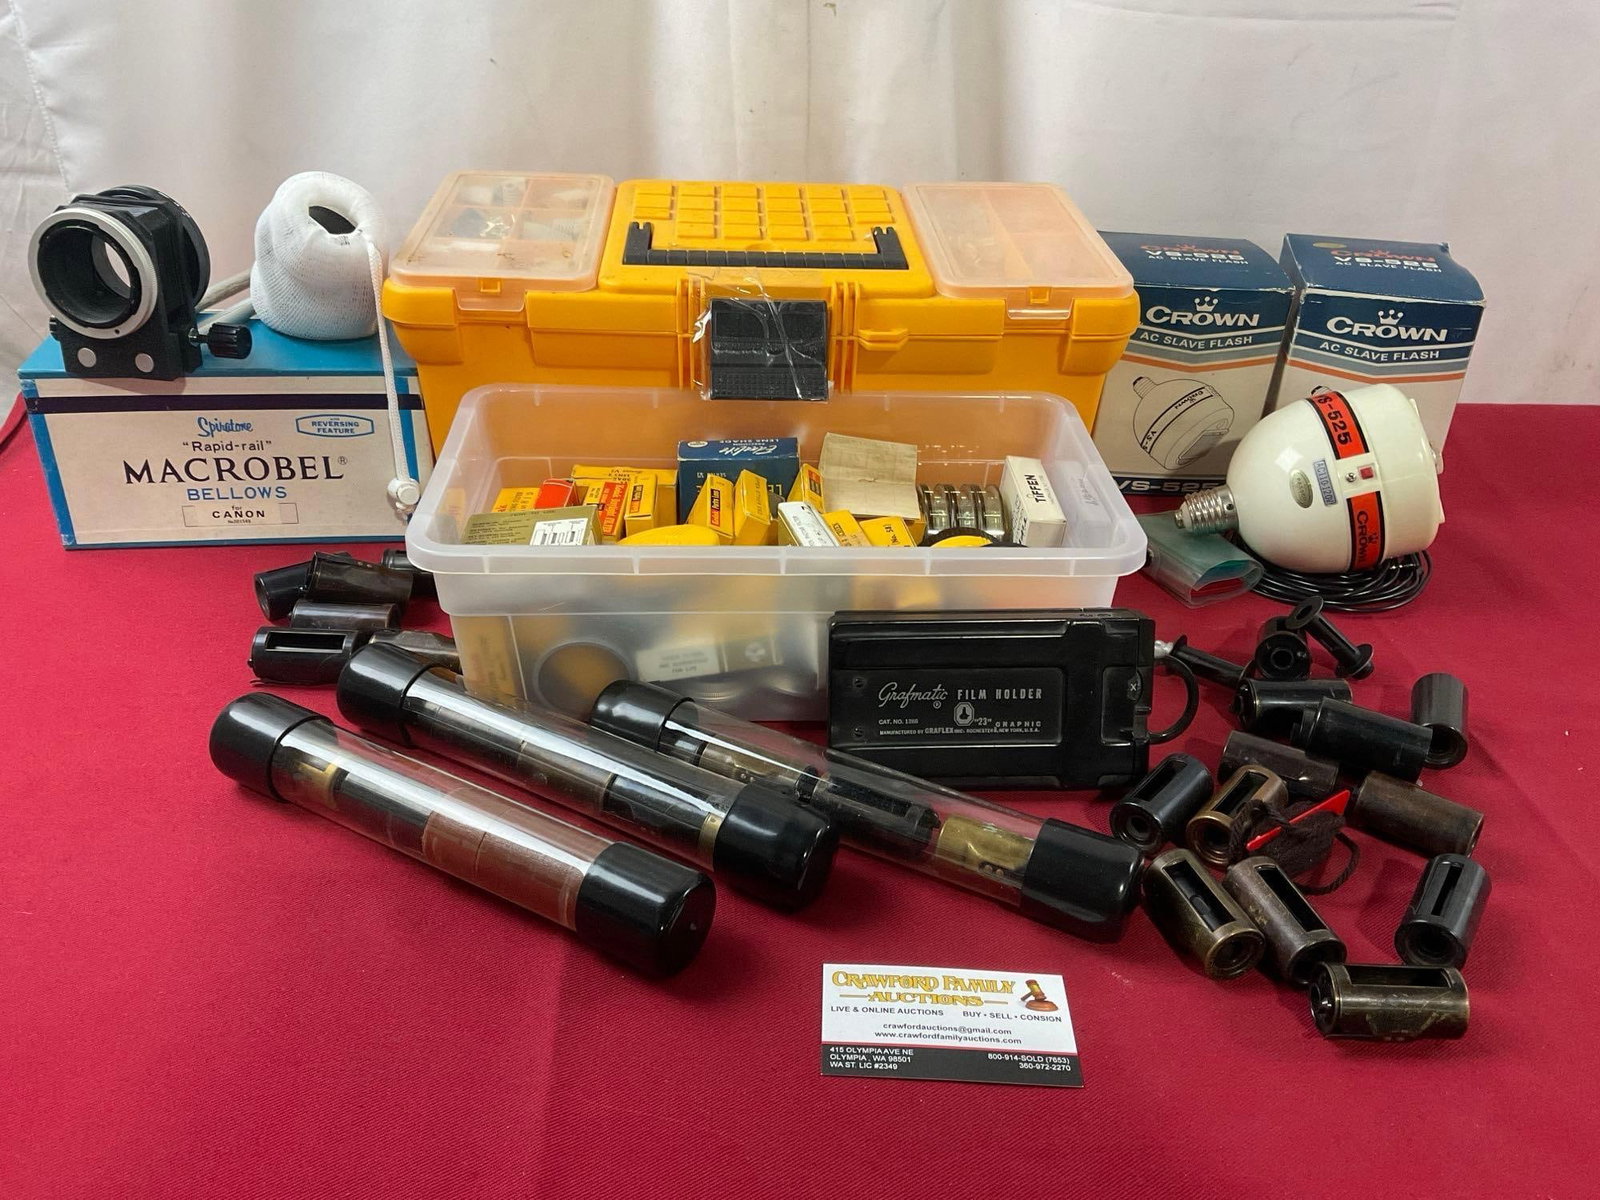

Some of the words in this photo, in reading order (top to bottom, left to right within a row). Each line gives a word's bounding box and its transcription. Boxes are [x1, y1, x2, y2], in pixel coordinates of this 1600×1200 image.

[1145, 250, 1245, 260] VS-525
[1333, 256, 1439, 269] VS-525
[1402, 265, 1442, 273] FLASH
[1145, 305, 1260, 327] CROWN
[1326, 316, 1448, 342] CROWN
[1139, 331, 1159, 342] AC
[1163, 335, 1206, 349] SLAVE
[1209, 335, 1253, 348] FLASH
[1319, 341, 1341, 352] AC
[1344, 346, 1389, 361] SLAVE
[1393, 350, 1440, 361] FLASH
[197, 416, 254, 438] Spiratone
[311, 420, 360, 428] REVERSING
[187, 485, 287, 501] BELLOWS
[1024, 474, 1047, 503] TIFFEN
[212, 510, 266, 518] CANON
[1356, 510, 1369, 564] CROWN
[878, 682, 948, 709] Grafmatic
[957, 689, 987, 700] FILM
[995, 688, 1042, 699] HOLDER
[831, 970, 939, 992] CRAWFORD
[942, 975, 1016, 994] FAMILY
[867, 991, 984, 1007] AUCTIONS
[897, 1008, 944, 1016] AUCTIONS
[962, 1010, 982, 1018] BUY
[989, 1012, 1013, 1020] SELL
[1020, 1014, 1062, 1022] CONSIGN
[882, 1023, 1012, 1035] crawfordauctions@gmail.com
[874, 1031, 1022, 1044] www.crawfordfamilyauctions.com
[829, 1053, 867, 1061] OLYMPIA
[888, 1055, 912, 1063] 98501
[987, 1053, 1043, 1062] 800-914-SOLD
[1045, 1056, 1070, 1065] (7653)
[1019, 1063, 1072, 1071] 360-972-2270
